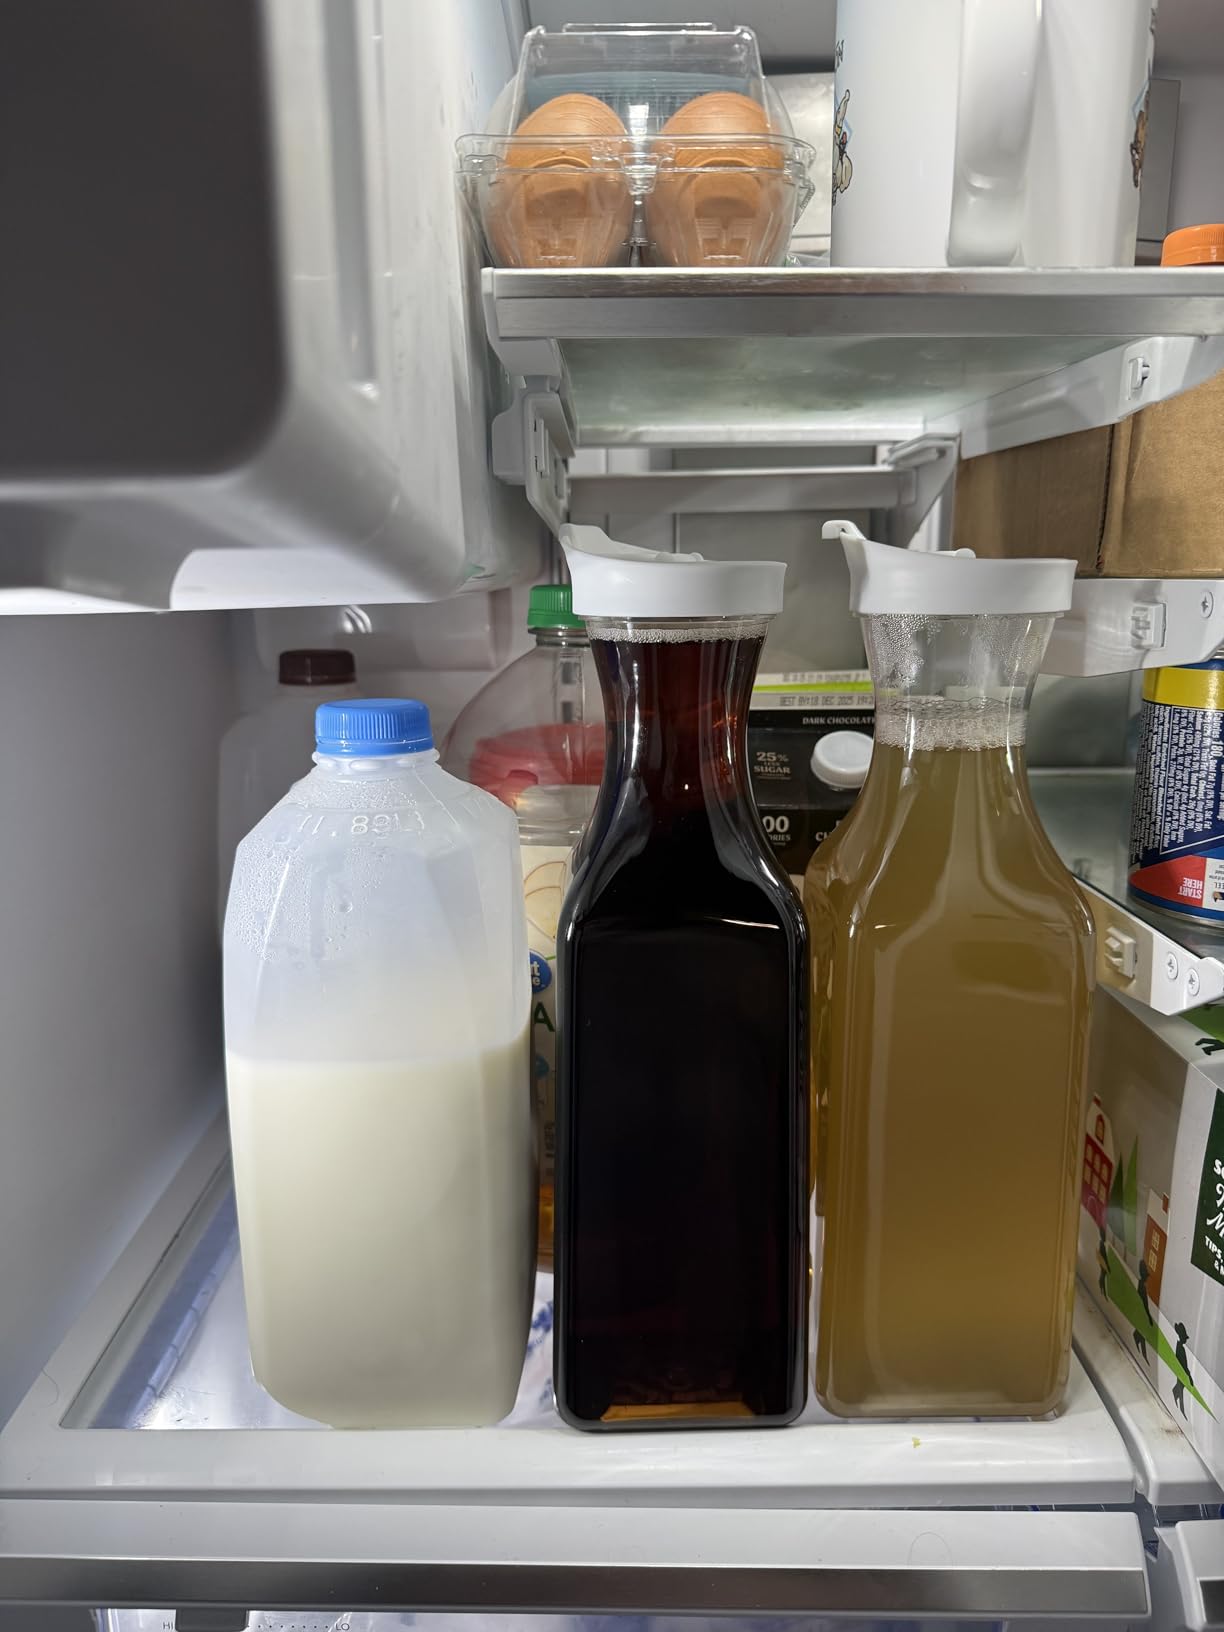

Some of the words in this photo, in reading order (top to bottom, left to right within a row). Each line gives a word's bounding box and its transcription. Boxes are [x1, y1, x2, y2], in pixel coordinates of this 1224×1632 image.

[802, 716, 825, 725] DARK
[1213, 712, 1223, 738] Calories
[1209, 740, 1224, 759] 180,
[756, 751, 789, 762] 25%
[753, 765, 791, 774] SUGAR
[1208, 772, 1216, 780] Fat
[1182, 877, 1203, 890] HERE
[1177, 886, 1202, 899] START
[335, 1623, 350, 1631] LO
